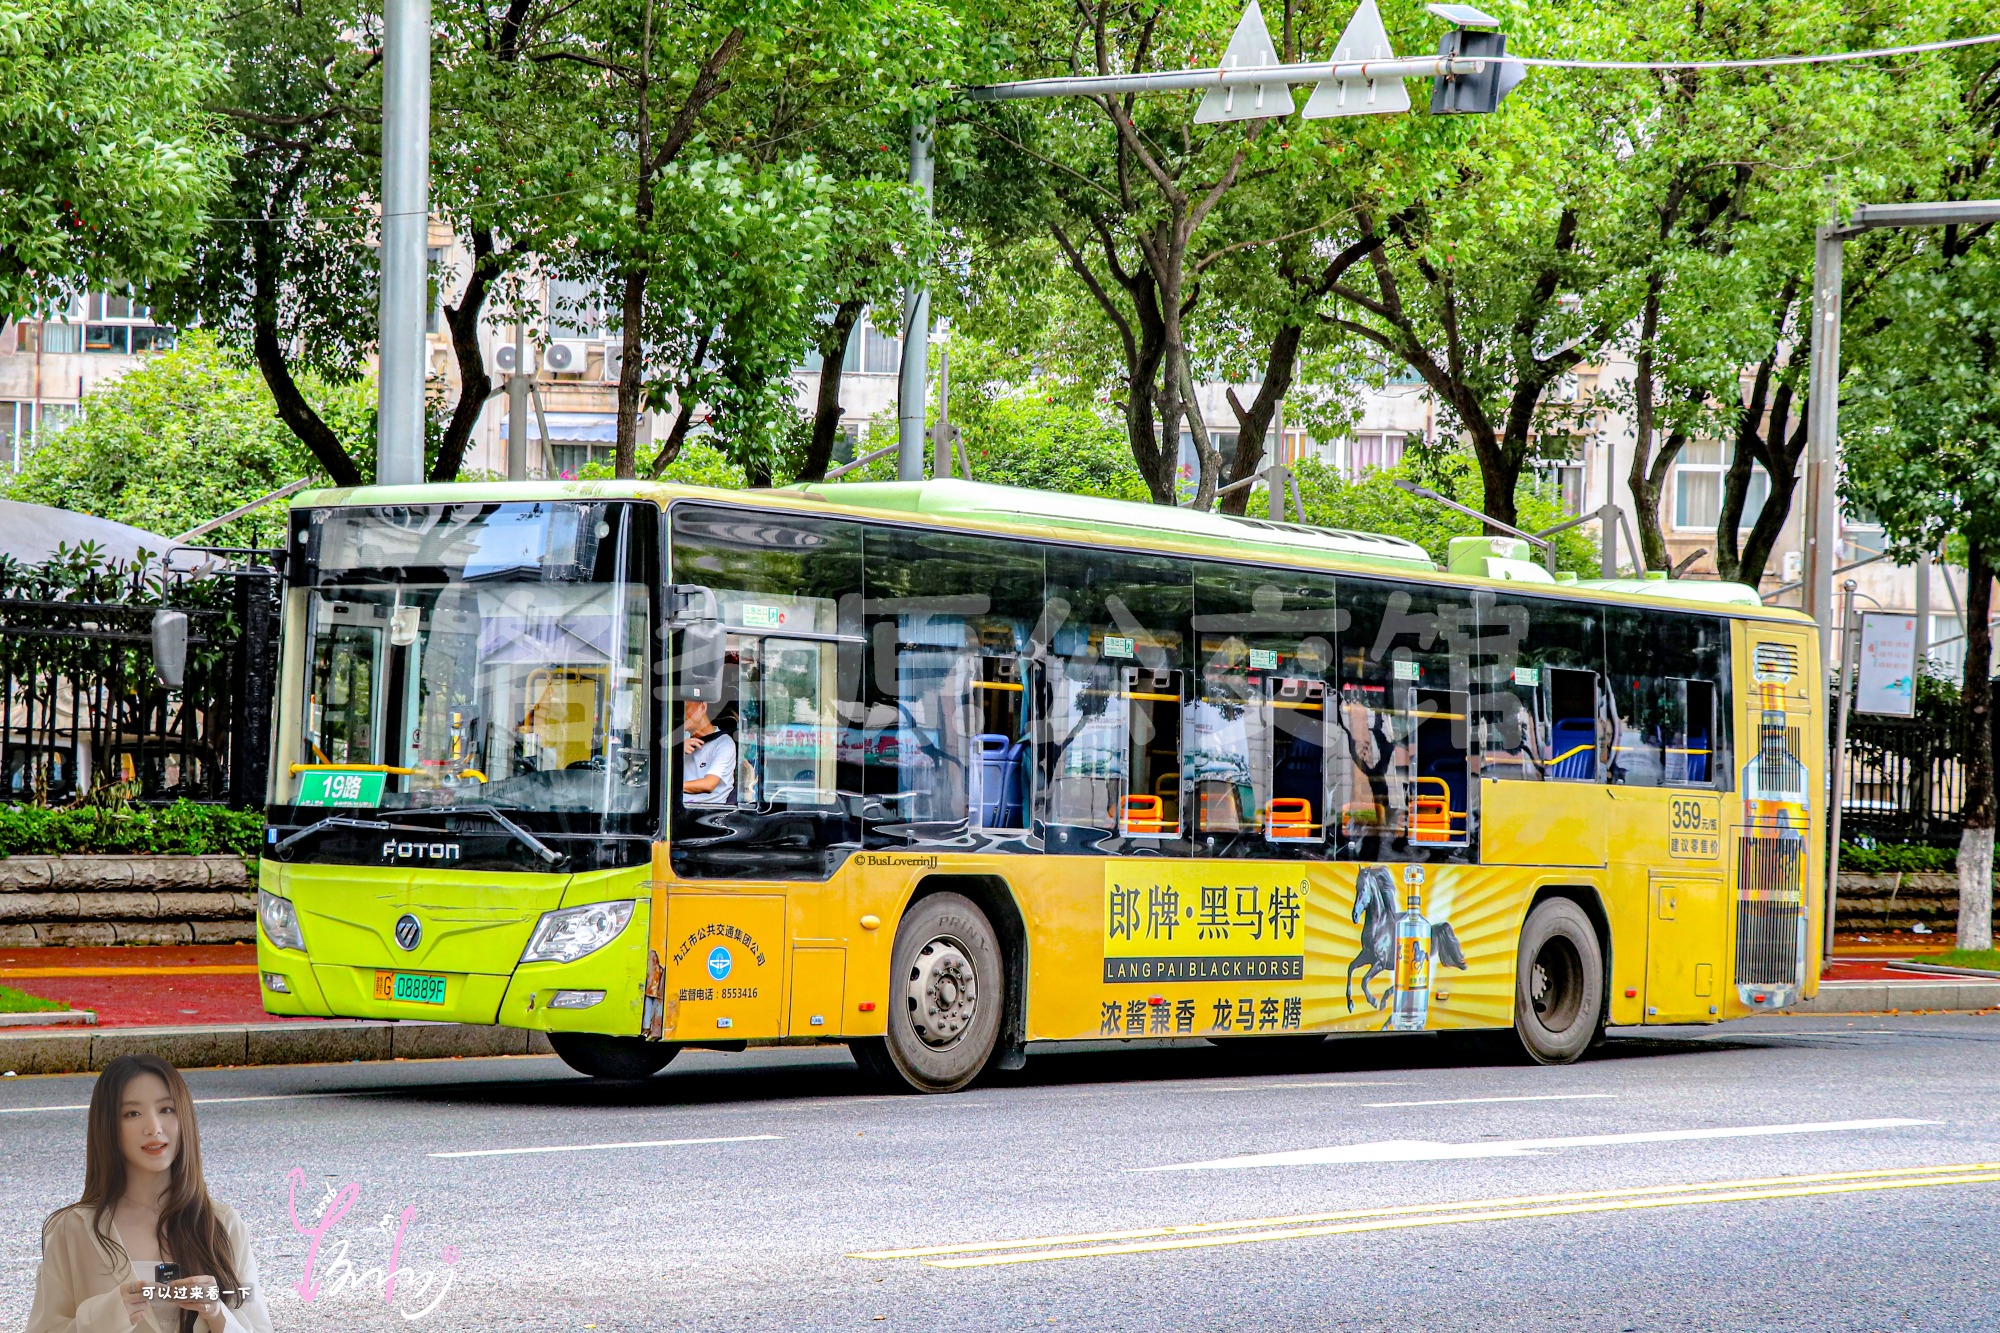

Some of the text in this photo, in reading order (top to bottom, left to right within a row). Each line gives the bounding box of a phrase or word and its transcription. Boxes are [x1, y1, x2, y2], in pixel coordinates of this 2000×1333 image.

[322, 775, 362, 800] 19路
[1672, 800, 1701, 829] 359
[382, 841, 461, 860] FOTON
[1671, 837, 1718, 854] 建议零售价
[1109, 883, 1301, 941] 郎牌·黑马特
[673, 923, 766, 967] 九江市公共交通集团公司
[1107, 960, 1300, 978] LANG PAI BLACK HORSE
[1100, 995, 1302, 1036] 浓酱兼香 龙马奔腾
